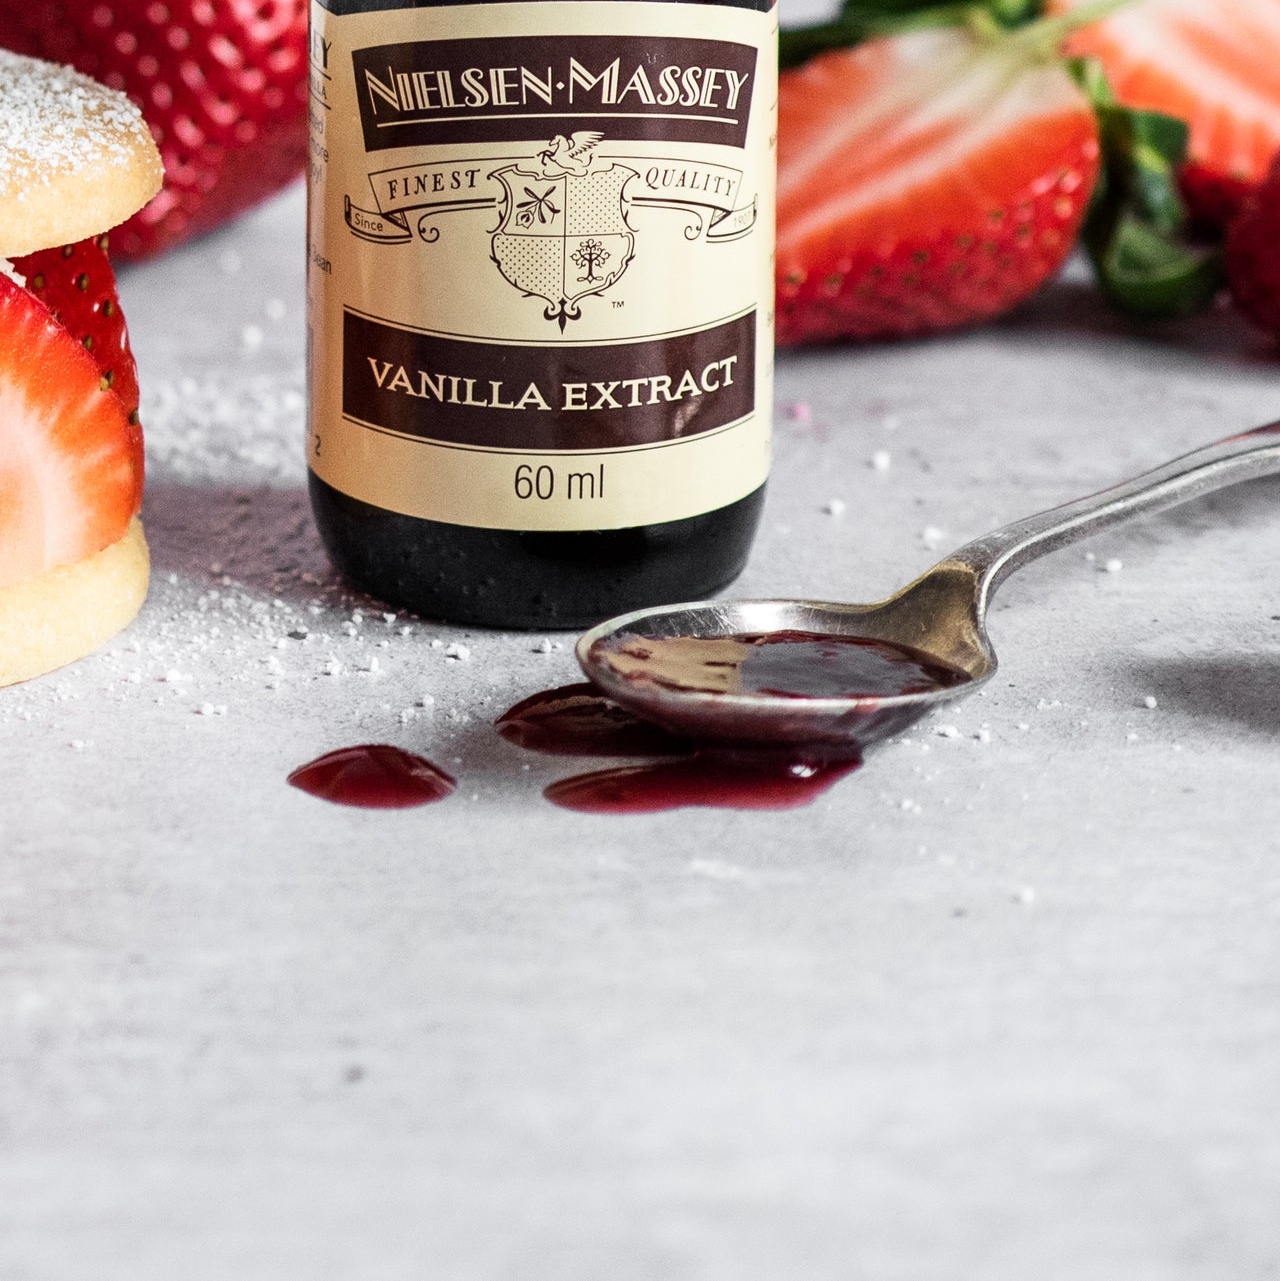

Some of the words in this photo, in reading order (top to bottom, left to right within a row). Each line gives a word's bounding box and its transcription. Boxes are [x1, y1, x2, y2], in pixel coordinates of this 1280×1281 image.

[388, 168, 482, 200] FINEST
[644, 166, 737, 197] QUALITY
[354, 212, 384, 232] Since
[366, 356, 552, 411] VANILLA
[561, 354, 738, 411] EXTRACT
[513, 464, 555, 500] 60
[567, 463, 605, 499] ml
